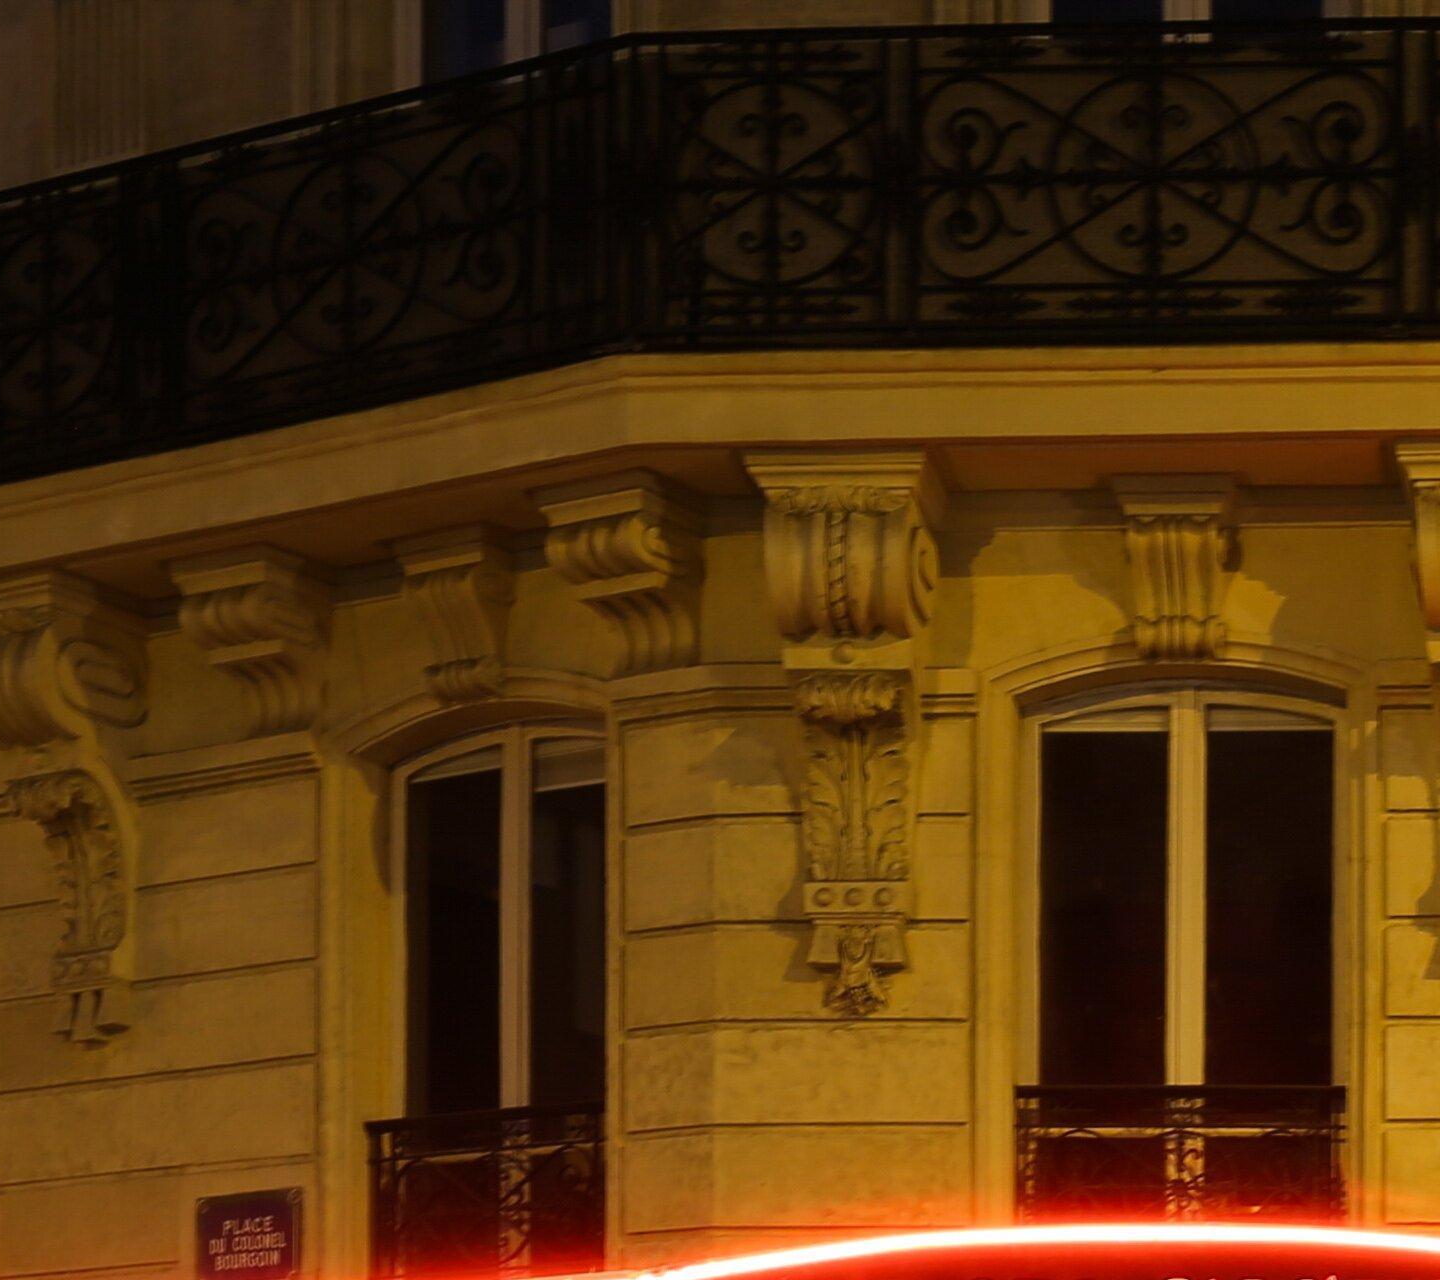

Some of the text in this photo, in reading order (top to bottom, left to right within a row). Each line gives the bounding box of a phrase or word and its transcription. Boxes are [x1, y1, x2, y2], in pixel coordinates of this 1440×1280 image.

[221, 1215, 275, 1237] PLACE
[208, 1230, 288, 1255] DU COLONEL
[214, 1249, 282, 1272] BOURGOIN
